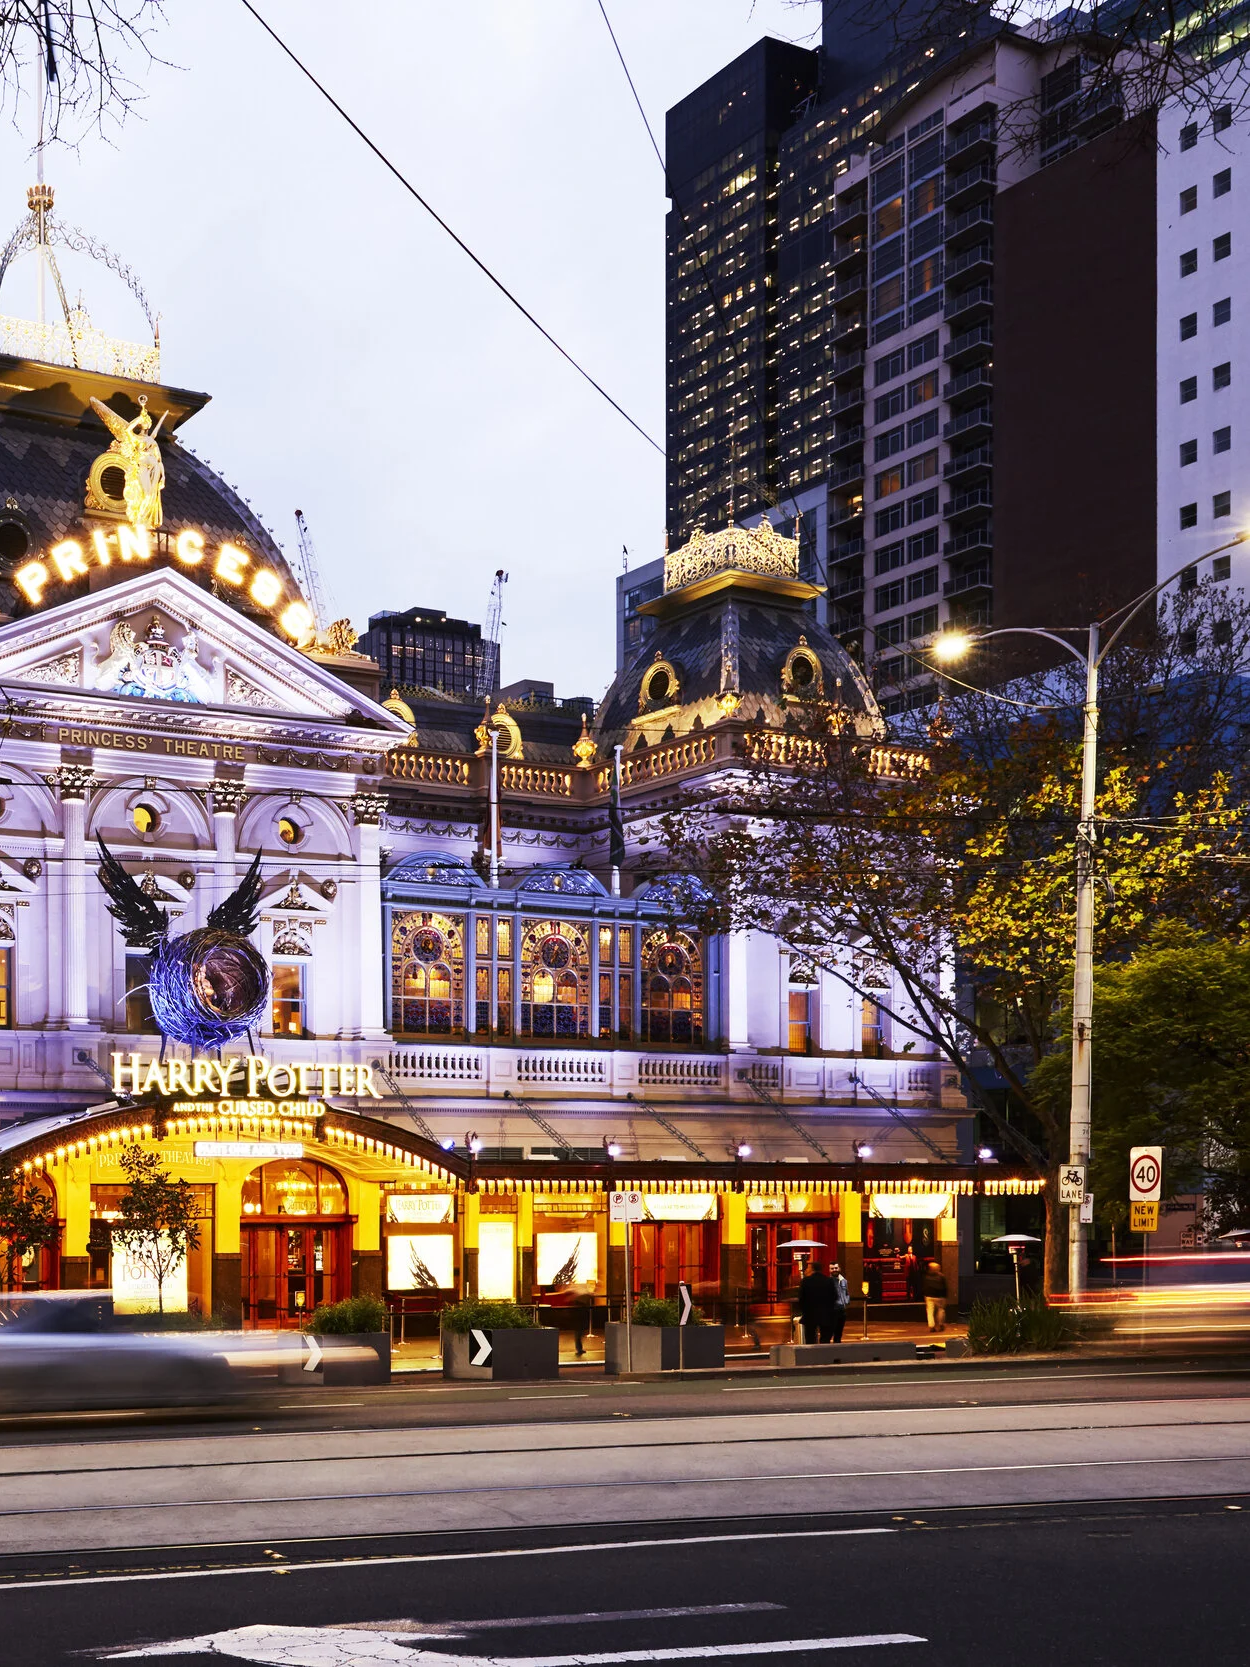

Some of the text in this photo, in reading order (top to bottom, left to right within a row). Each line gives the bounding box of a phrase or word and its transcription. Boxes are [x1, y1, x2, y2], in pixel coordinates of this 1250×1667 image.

[14, 523, 313, 638] PRINCESS
[164, 738, 246, 761] THEATRE
[111, 1052, 384, 1100] HARRY POTTER
[173, 1102, 194, 1113] AND
[217, 1100, 276, 1117] CURSED
[278, 1101, 326, 1117] CHILD
[159, 1150, 211, 1167] THEATRE
[1136, 1165, 1156, 1183] 40
[1061, 1189, 1083, 1199] LANE
[1134, 1205, 1154, 1215] NEW
[1133, 1217, 1155, 1228] LIMIT
